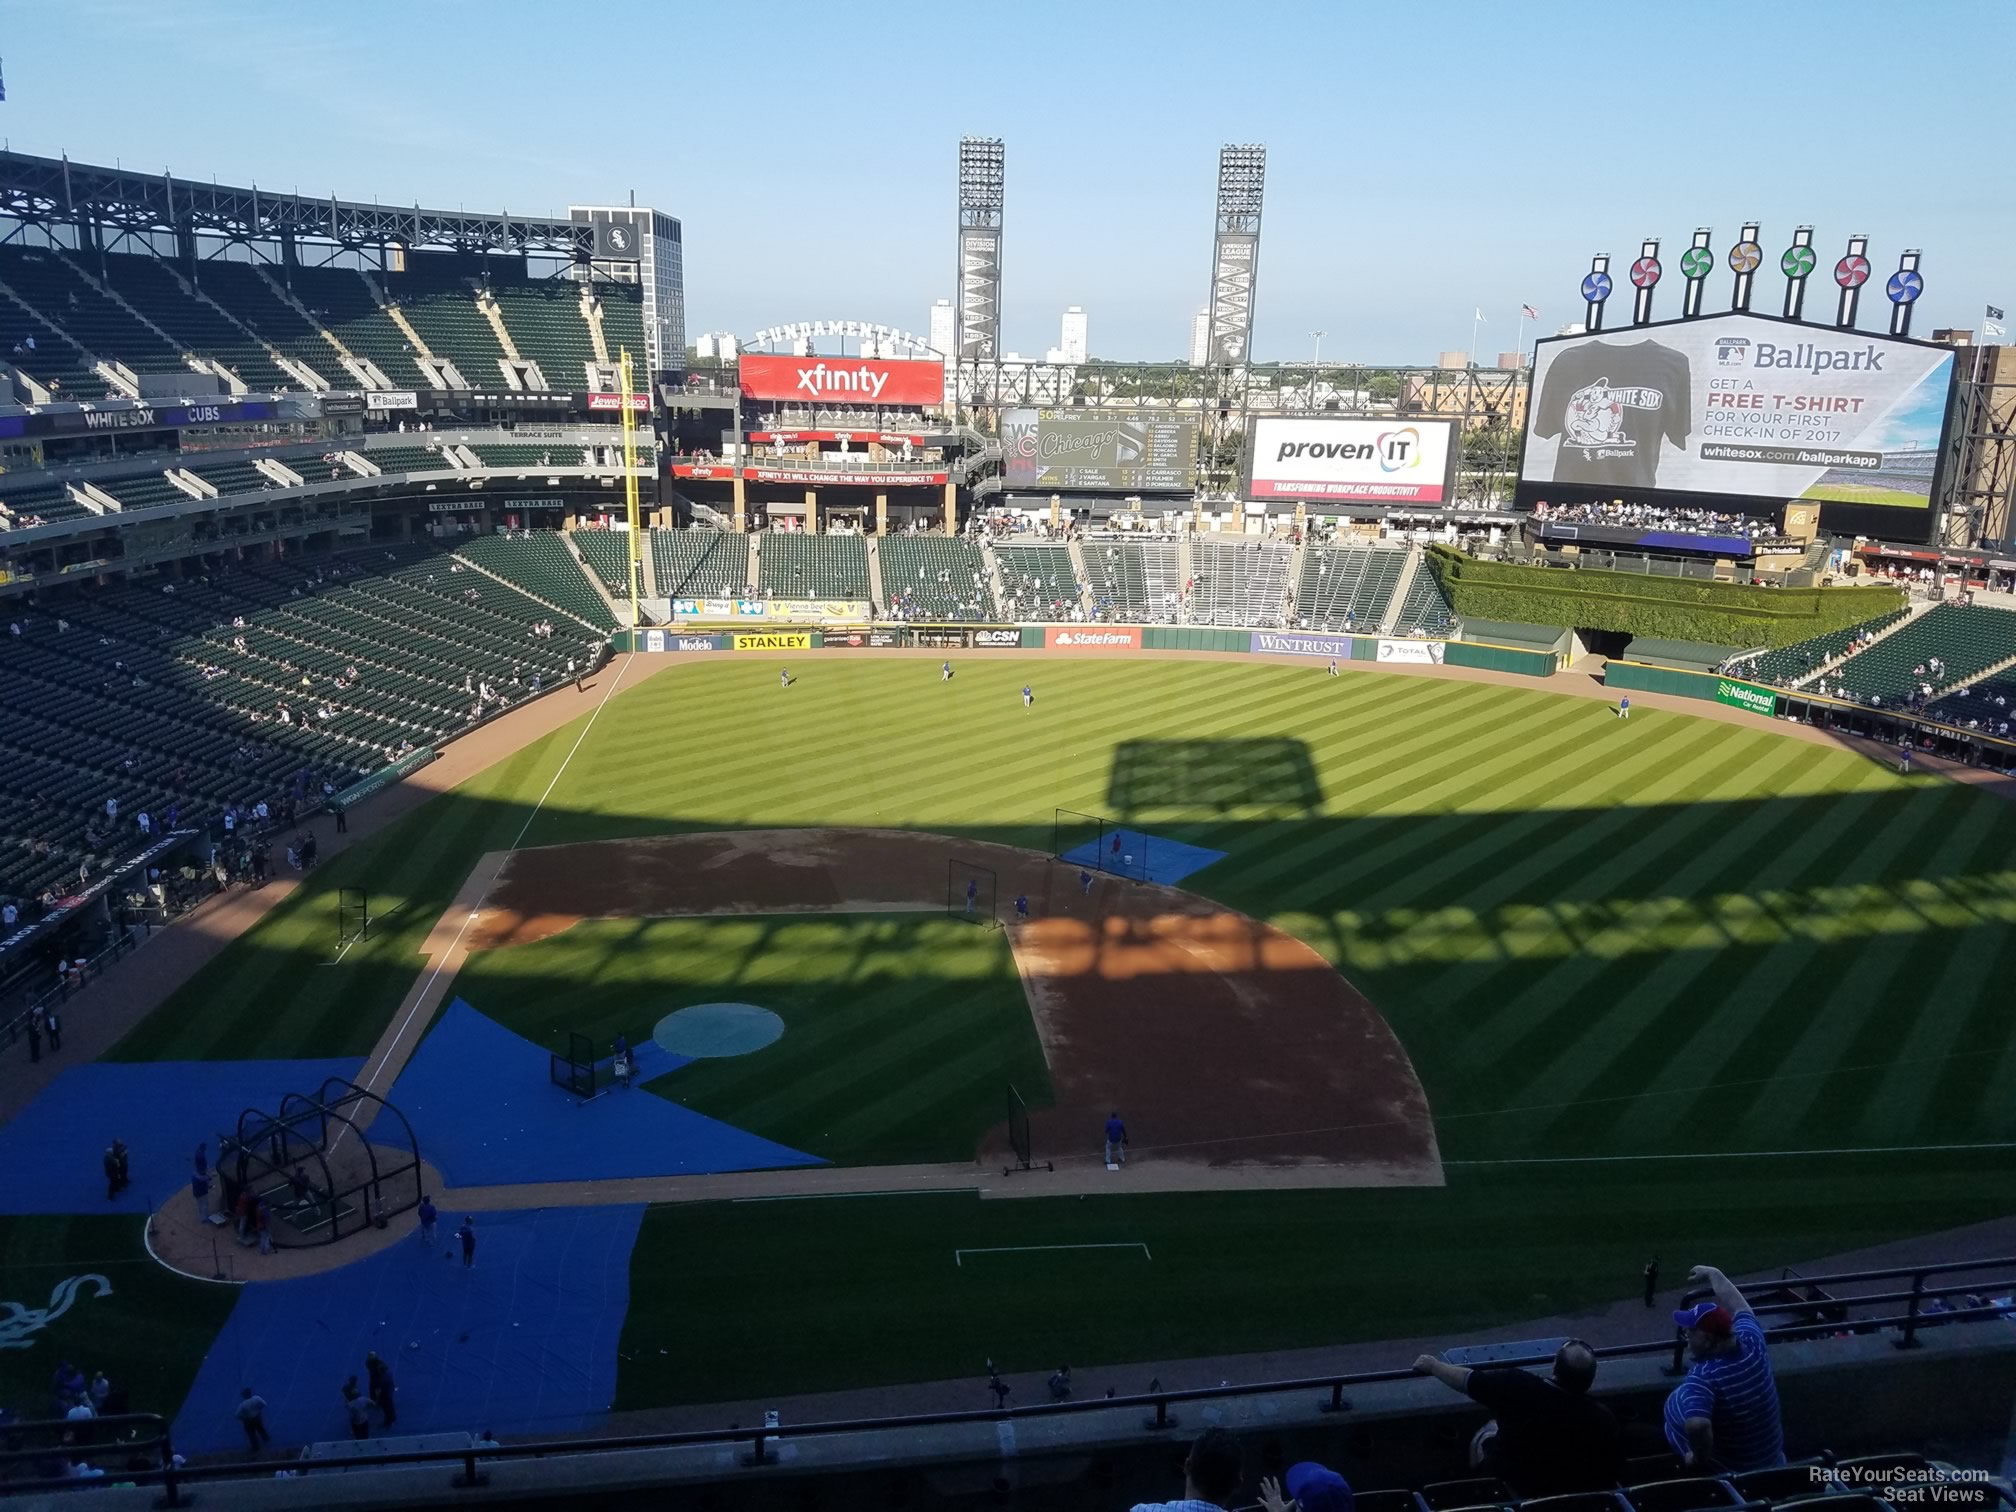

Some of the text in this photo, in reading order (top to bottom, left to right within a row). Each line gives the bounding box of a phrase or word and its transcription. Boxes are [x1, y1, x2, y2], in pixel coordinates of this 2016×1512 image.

[755, 320, 928, 352] FUNDAMENTALS
[1754, 343, 1885, 375] Ballpark
[797, 363, 889, 397] xfinity
[1710, 379, 1754, 390] GET A
[382, 396, 413, 407] Ballpark
[1607, 389, 1661, 407] WHITE SOX
[1707, 392, 1865, 413] FREE T-SHIRT
[85, 409, 155, 429] WHITE SOX
[188, 406, 220, 423] CUBS
[1039, 410, 1054, 420] 50
[1705, 411, 1831, 427] FOR YOUR FIRST
[1703, 425, 1841, 442] CHECK-IN OF 2017
[1040, 429, 1118, 460] Chicago
[1277, 441, 1411, 462] proven IT
[1605, 449, 1634, 458] Ballpark
[692, 468, 713, 476] xfinity
[809, 474, 838, 482] CHANGE
[1273, 482, 1420, 496] TRANSFORMING WORKPLACE PRODUCTIVITY
[436, 502, 463, 510] EXTRA
[739, 636, 805, 648] STANLEY
[991, 631, 1020, 641] CSN
[1258, 635, 1345, 653] WINTRUST
[679, 639, 713, 651] Modelo
[1730, 686, 1773, 706] National
[1752, 703, 1770, 713] Rental
[1911, 721, 1933, 734] THE
[114, 838, 178, 873] WELCOME TO
